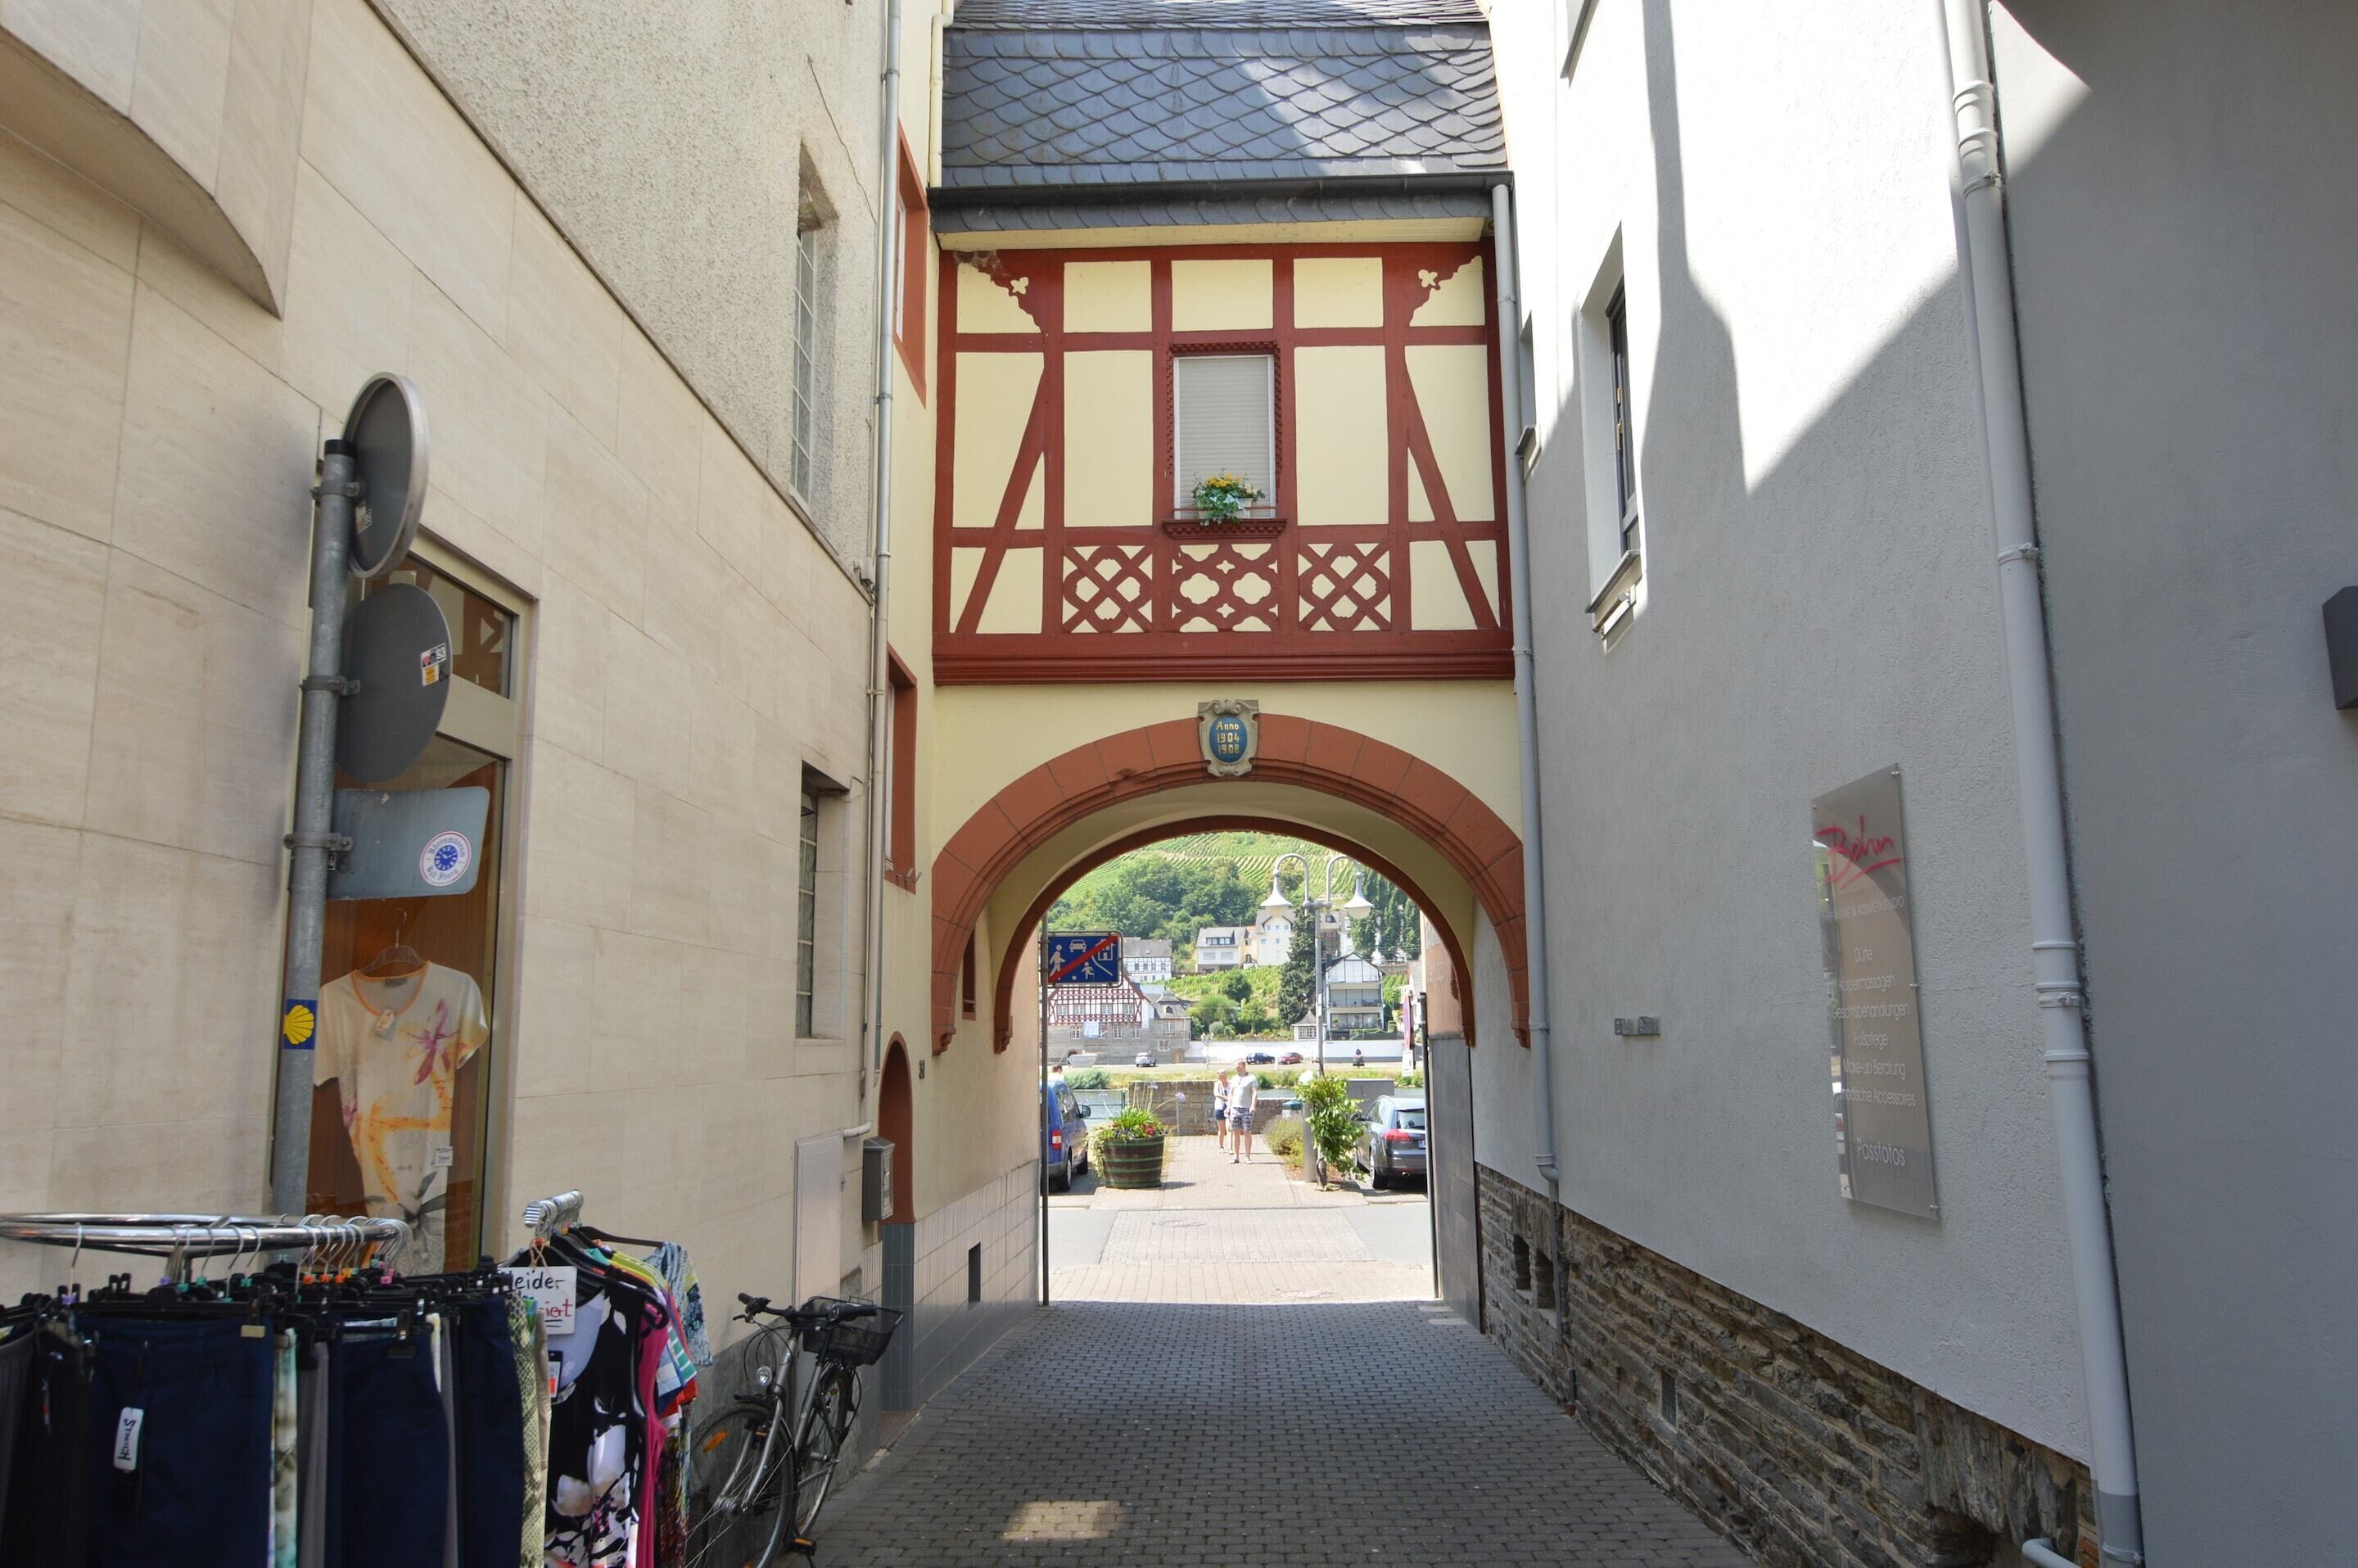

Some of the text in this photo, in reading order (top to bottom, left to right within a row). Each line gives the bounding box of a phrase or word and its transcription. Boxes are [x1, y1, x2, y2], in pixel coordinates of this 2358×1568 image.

[1216, 721, 1240, 730] Anno
[1217, 733, 1240, 743] 1904
[1218, 744, 1240, 754] 1908
[1873, 1060, 1906, 1080] Beratung
[1872, 1088, 1917, 1106] Accessoires
[1856, 1137, 1906, 1167] Passfotos
